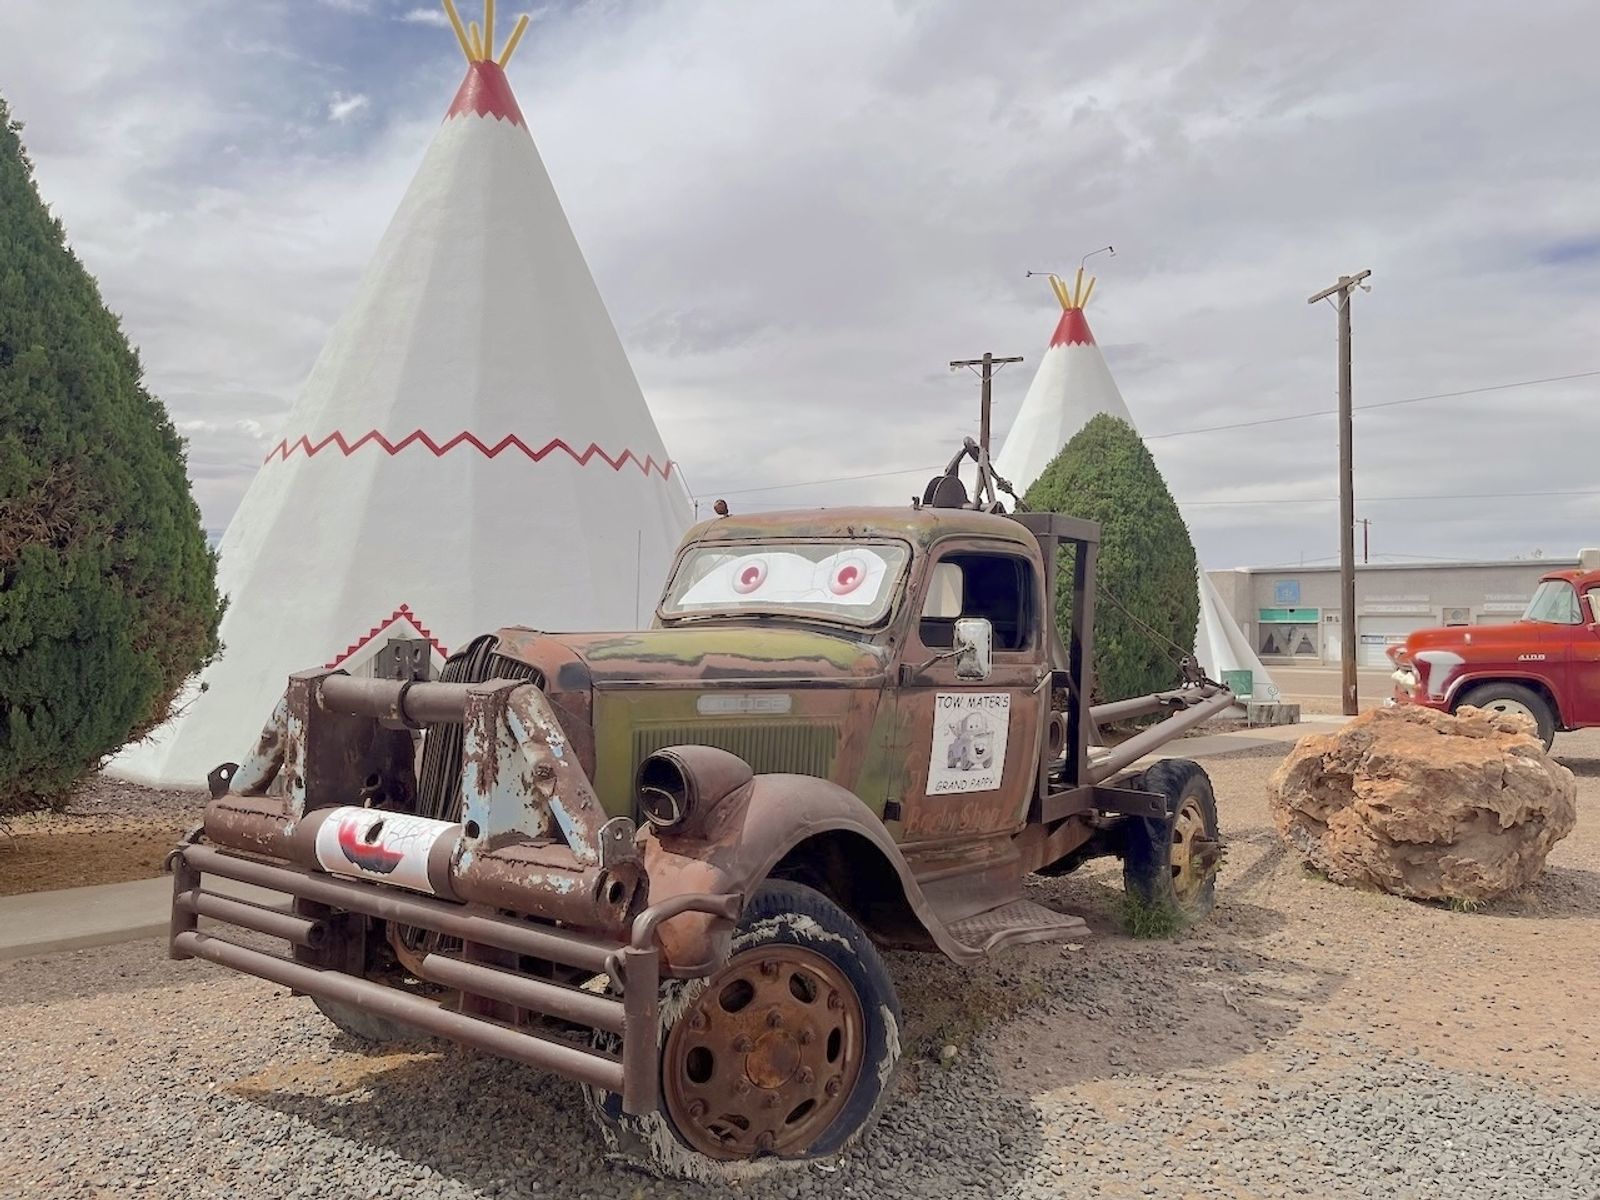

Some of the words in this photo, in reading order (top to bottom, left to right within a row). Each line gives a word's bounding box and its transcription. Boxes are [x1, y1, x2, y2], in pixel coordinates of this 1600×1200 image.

[702, 698, 786, 711] DGE
[937, 696, 963, 708] TOW
[935, 779, 967, 792] GRAND
